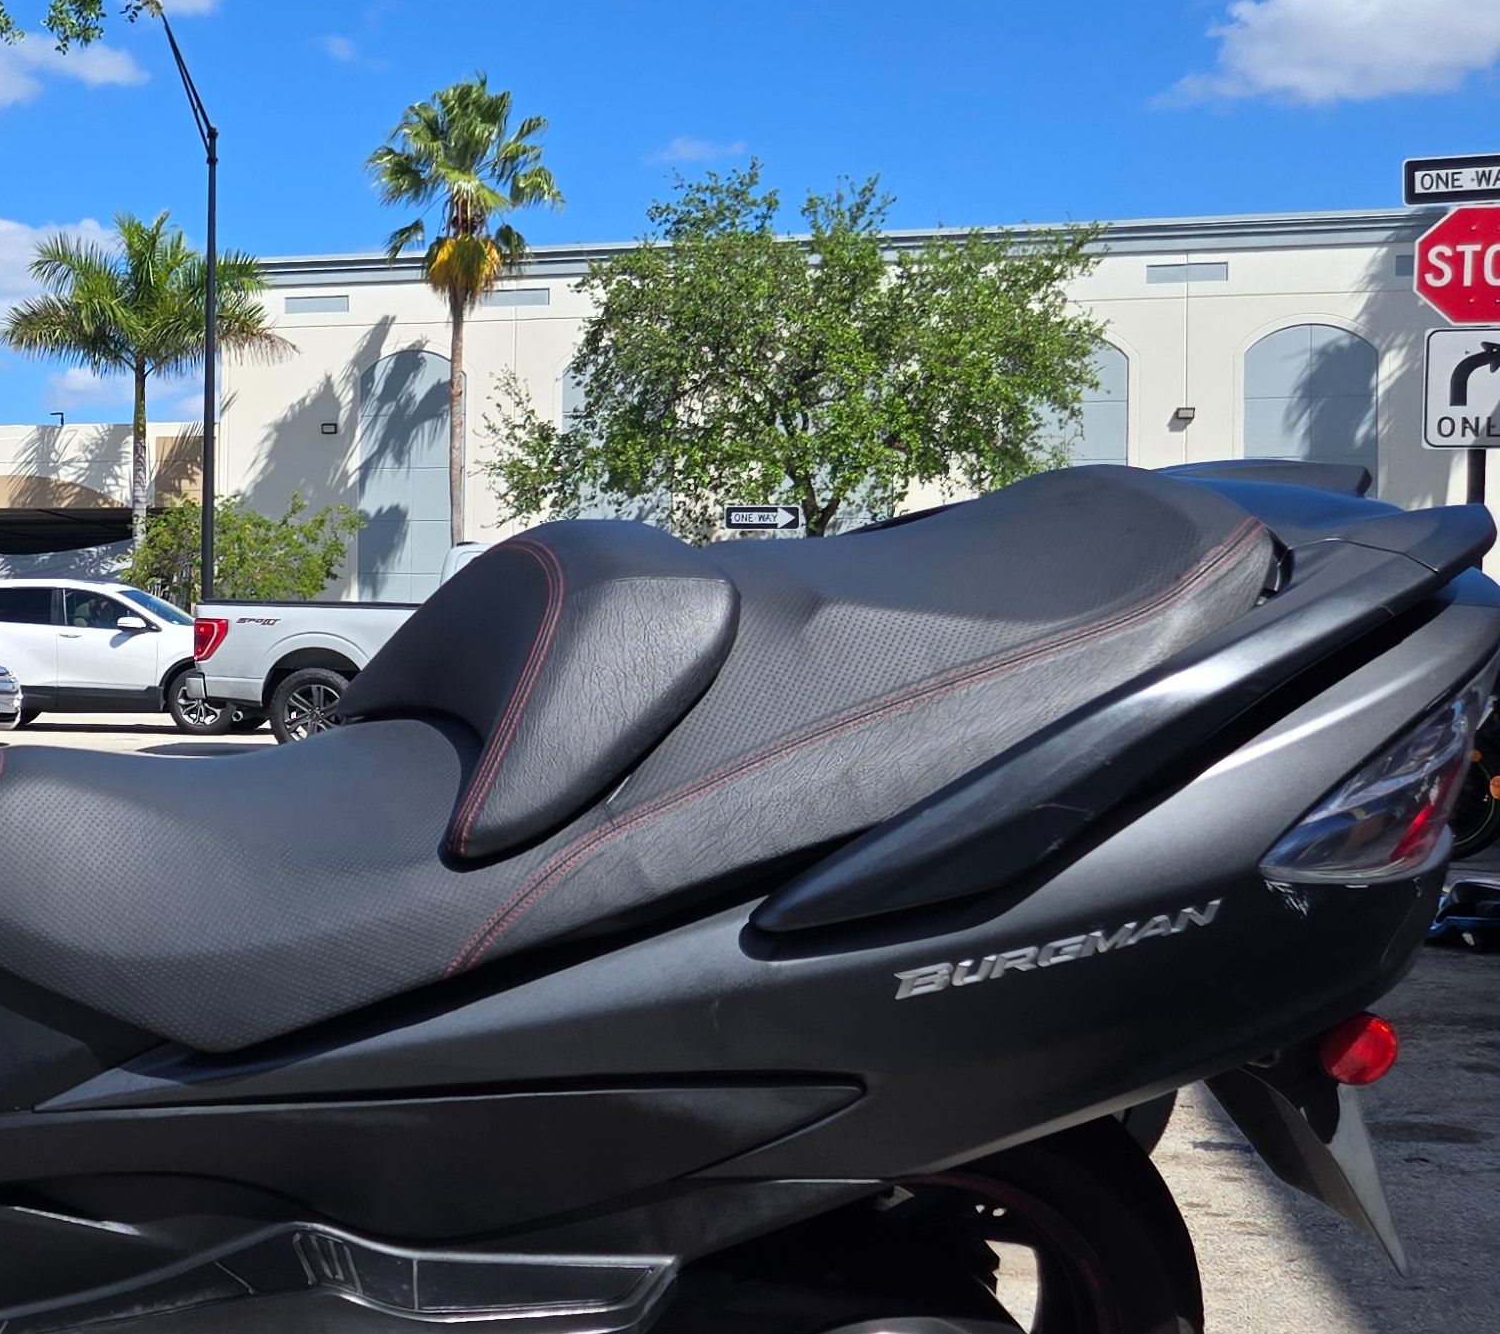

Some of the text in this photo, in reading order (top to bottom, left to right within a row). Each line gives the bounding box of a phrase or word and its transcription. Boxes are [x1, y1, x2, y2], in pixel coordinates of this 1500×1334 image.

[1420, 169, 1500, 190] ONE WA
[1424, 244, 1500, 287] STO
[1436, 416, 1500, 438] ONL
[734, 514, 777, 522] ONE WAY
[893, 897, 1223, 1001] BURGMAN
